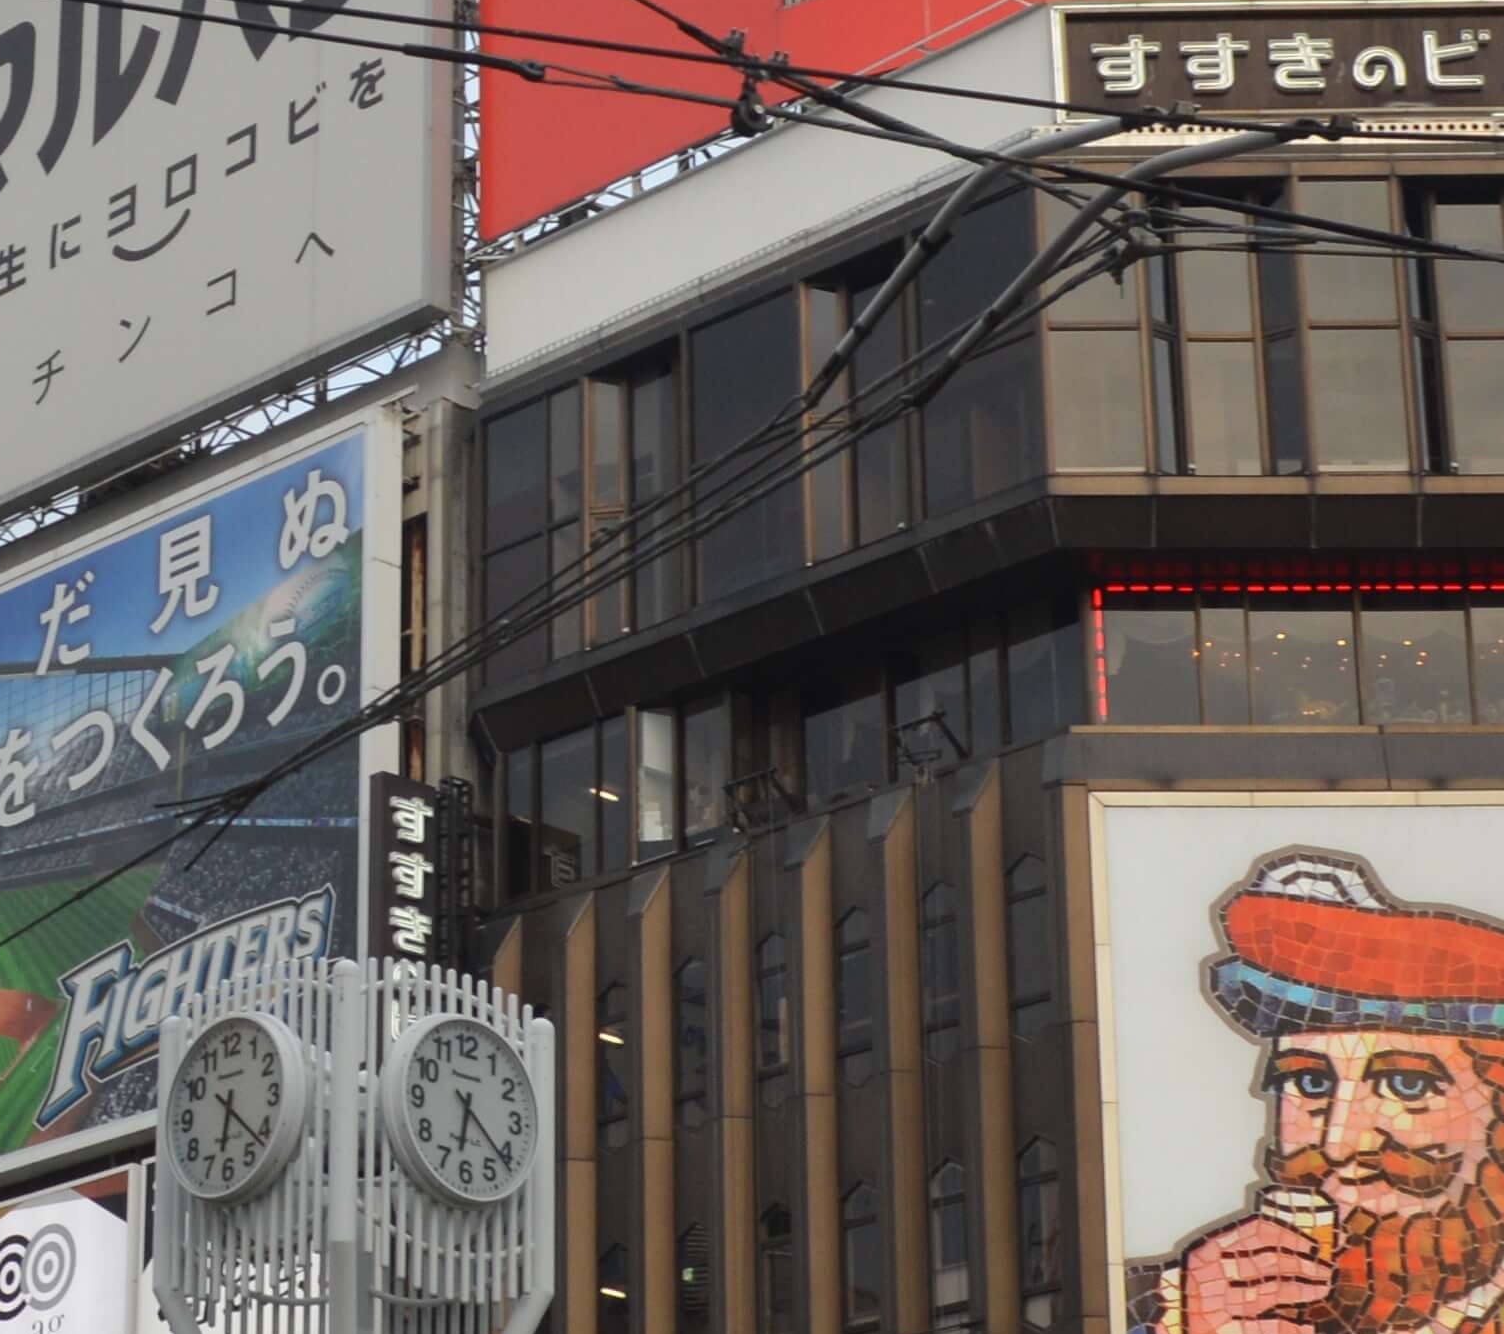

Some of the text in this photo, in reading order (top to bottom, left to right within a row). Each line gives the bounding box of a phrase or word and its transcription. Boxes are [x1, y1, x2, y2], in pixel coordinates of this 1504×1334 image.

[35, 883, 336, 1129] FIGHTERS
[220, 1033, 241, 1057] 12
[249, 1037, 257, 1059] 1
[434, 1036, 452, 1063] 11
[457, 1036, 478, 1060] 12
[202, 1048, 218, 1072] 11
[261, 1052, 274, 1075] 2
[416, 1057, 439, 1082] 10
[489, 1053, 497, 1075] 1
[186, 1078, 205, 1101] 10
[267, 1083, 280, 1106] 3
[411, 1084, 424, 1108] 9
[502, 1078, 515, 1101] 2
[181, 1111, 192, 1133] 9
[419, 1118, 432, 1142] 8
[509, 1112, 522, 1135] 3
[187, 1139, 199, 1163] 8
[243, 1142, 256, 1166] 5
[438, 1146, 451, 1168] 7
[203, 1156, 216, 1179] 7
[222, 1161, 234, 1182] 6
[458, 1161, 472, 1183] 6
[483, 1157, 497, 1182] 5
